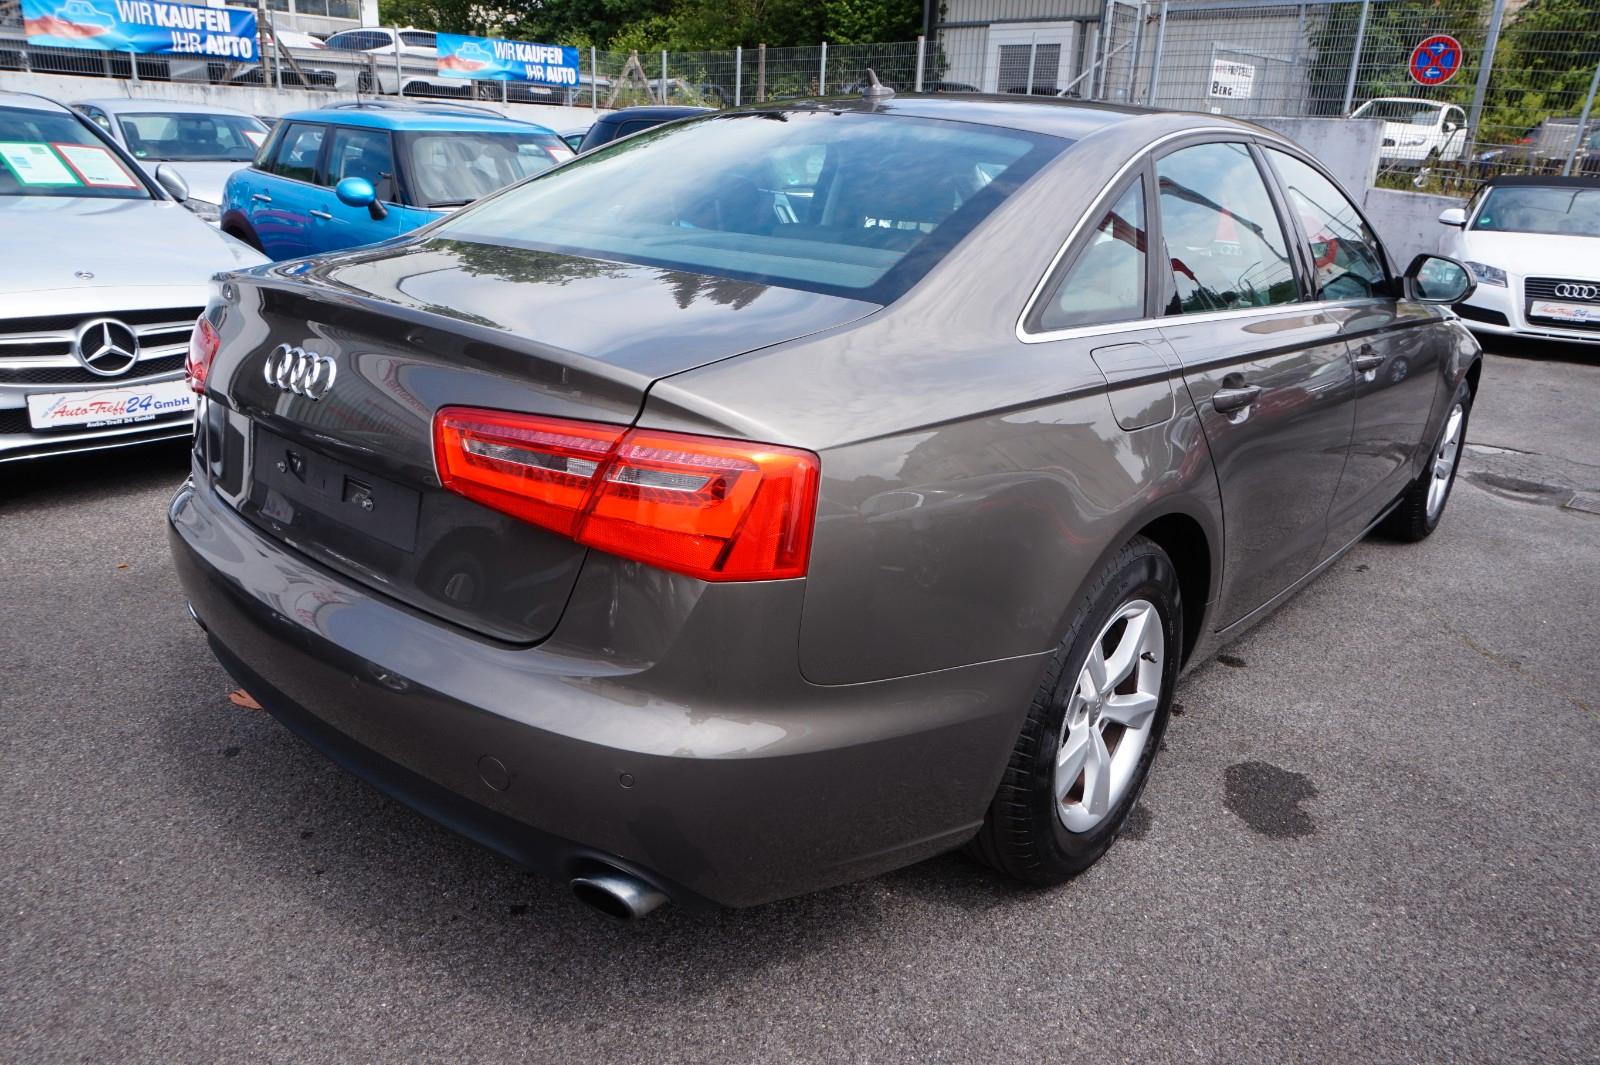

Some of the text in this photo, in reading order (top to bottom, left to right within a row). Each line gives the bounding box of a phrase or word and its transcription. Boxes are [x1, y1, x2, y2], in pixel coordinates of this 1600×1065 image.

[115, 0, 231, 33] WIR KAUFEN
[171, 31, 252, 59] IHR AUTO
[493, 41, 563, 65] WIR KAUFEN
[525, 64, 576, 85] IHR AUTO
[153, 397, 190, 410] GmbH
